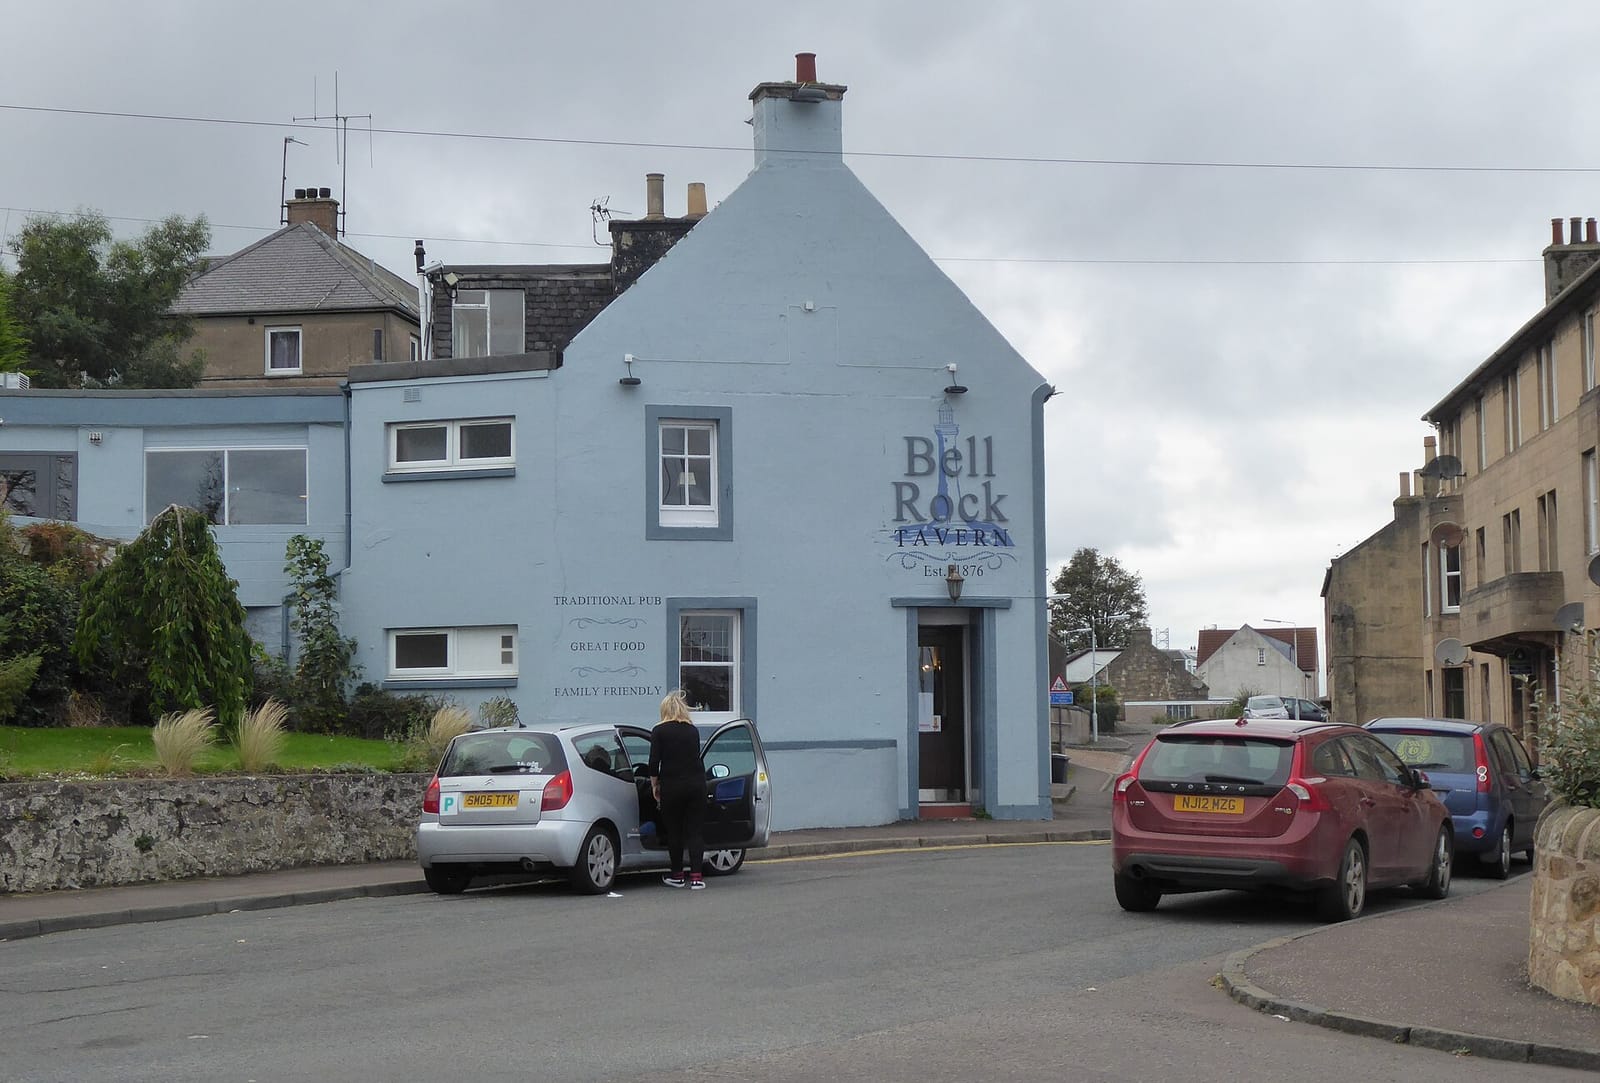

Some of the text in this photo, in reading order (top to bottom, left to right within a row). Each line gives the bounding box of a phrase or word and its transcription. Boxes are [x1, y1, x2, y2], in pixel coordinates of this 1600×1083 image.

[903, 435, 996, 478] Bell
[891, 480, 1009, 523] Rock
[894, 528, 1009, 548] TAVERN
[924, 564, 984, 577] Est. 1876
[553, 595, 662, 606] TRADITIONAL PUB
[570, 641, 646, 652] GREAT FOOD
[554, 686, 662, 697] FAMILY FRIENDLY
[444, 797, 454, 812] P
[495, 793, 515, 805] TTK
[1182, 796, 1236, 811] NJ12 MZG
